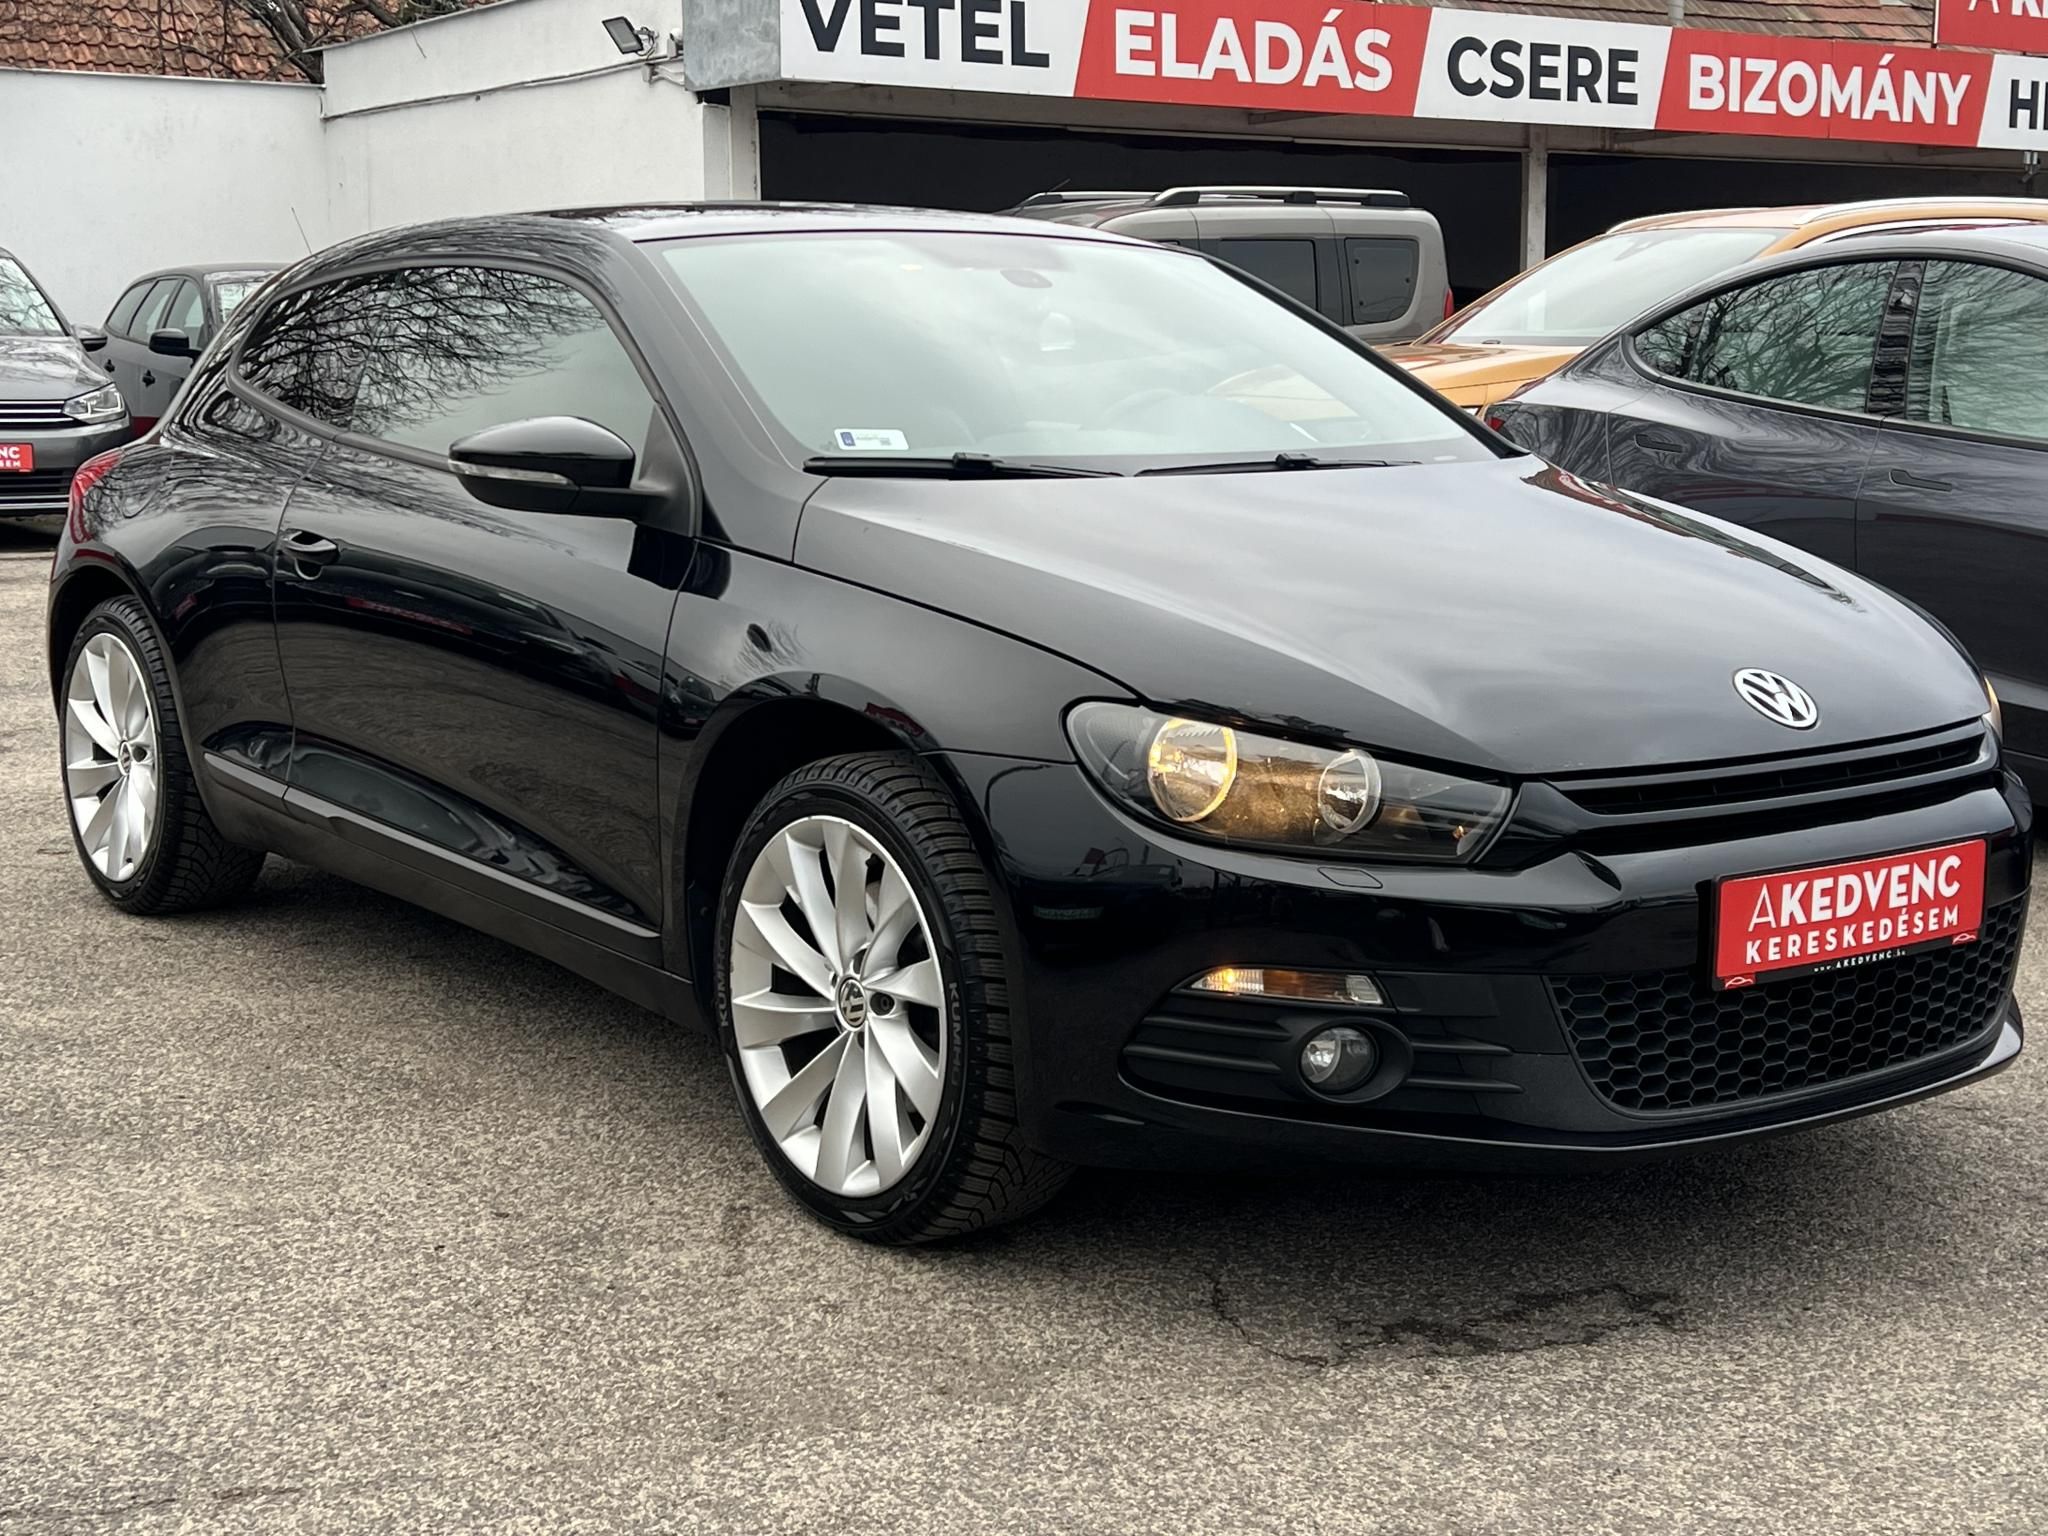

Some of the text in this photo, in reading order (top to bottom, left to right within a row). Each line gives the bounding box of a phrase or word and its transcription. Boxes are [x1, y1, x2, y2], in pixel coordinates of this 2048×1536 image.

[1115, 9, 1393, 93] ELADÁS
[1447, 36, 1639, 106] CSERE
[1689, 54, 1972, 126] BIZOMÁNY
[1745, 904, 1959, 965] KERESKEDÉSEM
